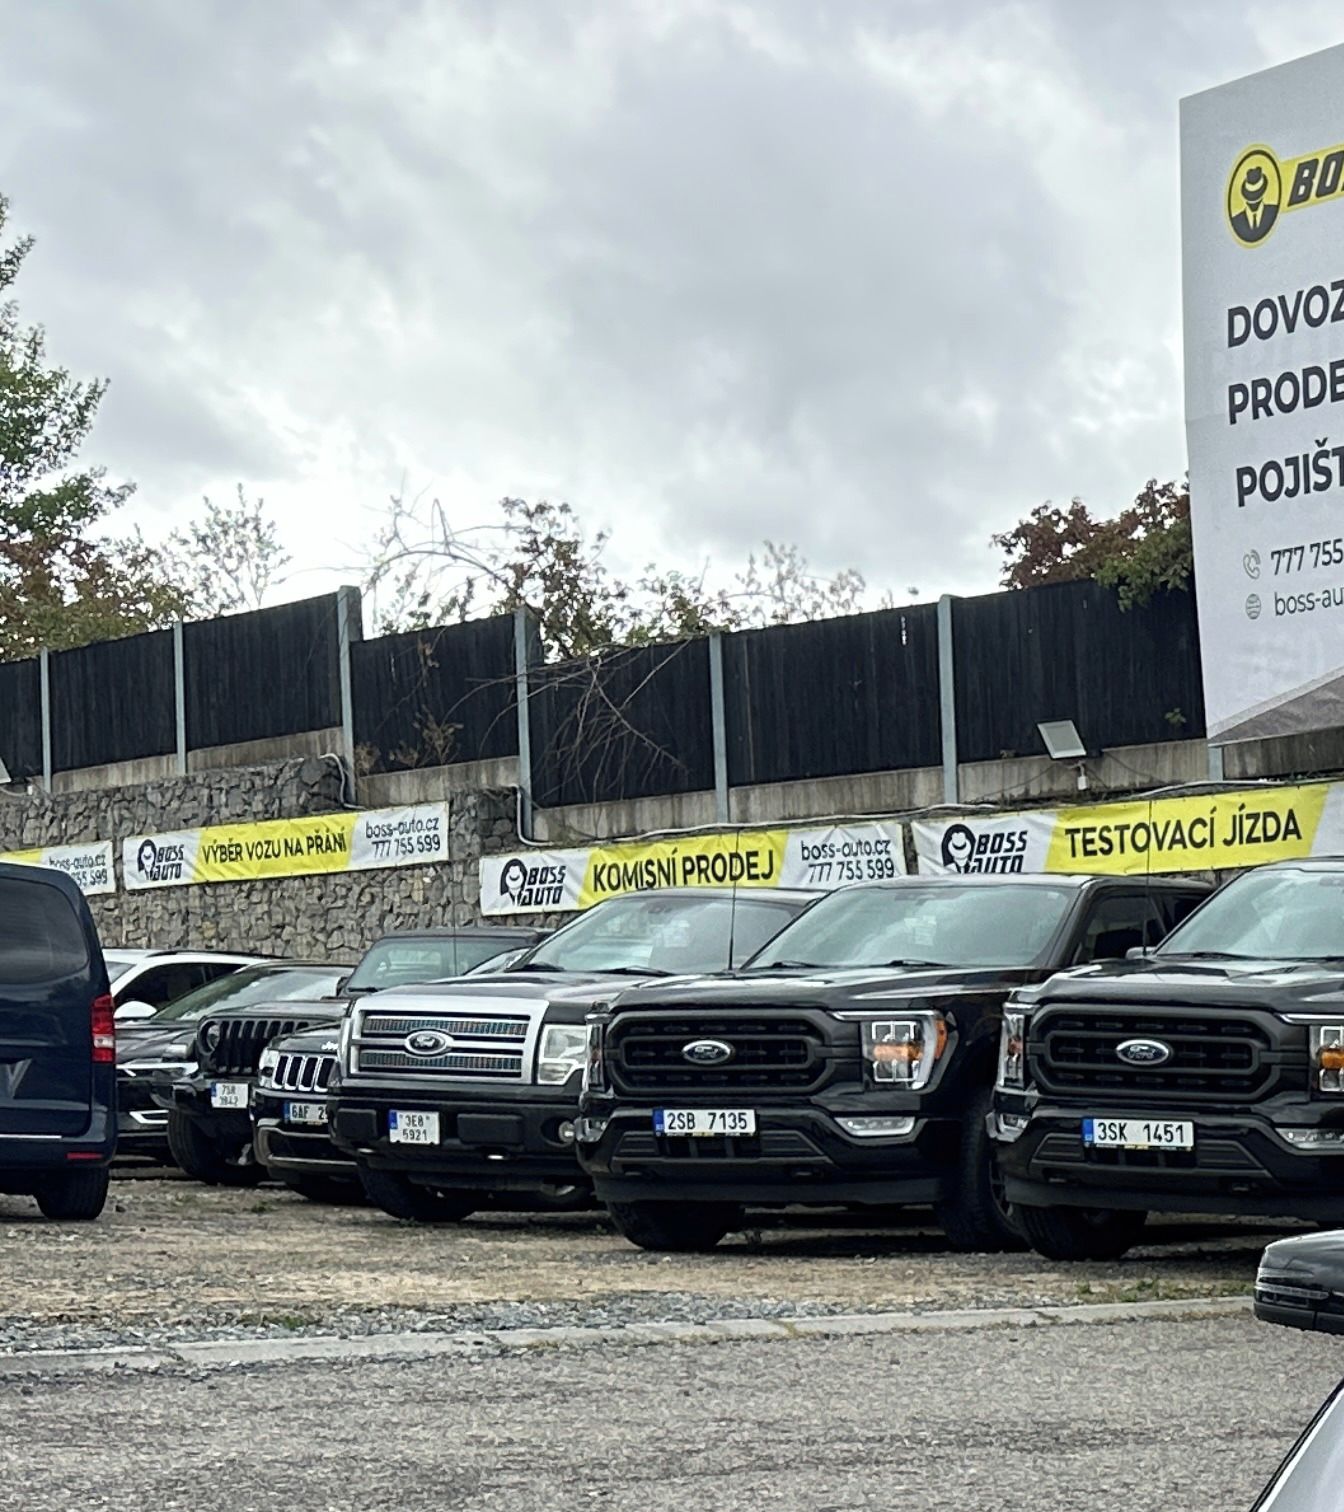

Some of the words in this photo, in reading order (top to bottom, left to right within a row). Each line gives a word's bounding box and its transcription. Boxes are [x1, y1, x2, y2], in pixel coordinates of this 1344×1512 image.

[1270, 546, 1305, 576] 777
[1310, 538, 1343, 568] 755
[366, 817, 440, 839] boss-auto.cz
[1065, 806, 1217, 858] TESTOVACÍ
[1222, 803, 1303, 847] JÍZDA
[156, 844, 185, 862] BOSS
[202, 838, 244, 864] VÝBĚR
[245, 839, 282, 860] VOZU
[284, 838, 304, 857] NA
[306, 826, 347, 856] PŘÁNÍ
[417, 833, 441, 853] 599
[801, 840, 891, 861] boss-auto.cz
[975, 830, 1028, 855] BOSS
[150, 863, 182, 881] AUTO
[527, 866, 567, 885] BOSS
[593, 847, 678, 893] KOMISNÍ
[683, 849, 774, 886] PRODEJ
[808, 862, 832, 882] 777
[836, 860, 863, 880] 755
[867, 858, 895, 879] 599
[520, 886, 564, 906] AUTO
[667, 1112, 696, 1130] 2SB
[707, 1112, 748, 1130] 7135
[402, 1128, 428, 1141] 5921
[1097, 1122, 1128, 1142] 3SK
[1143, 1123, 1185, 1143] 1451
